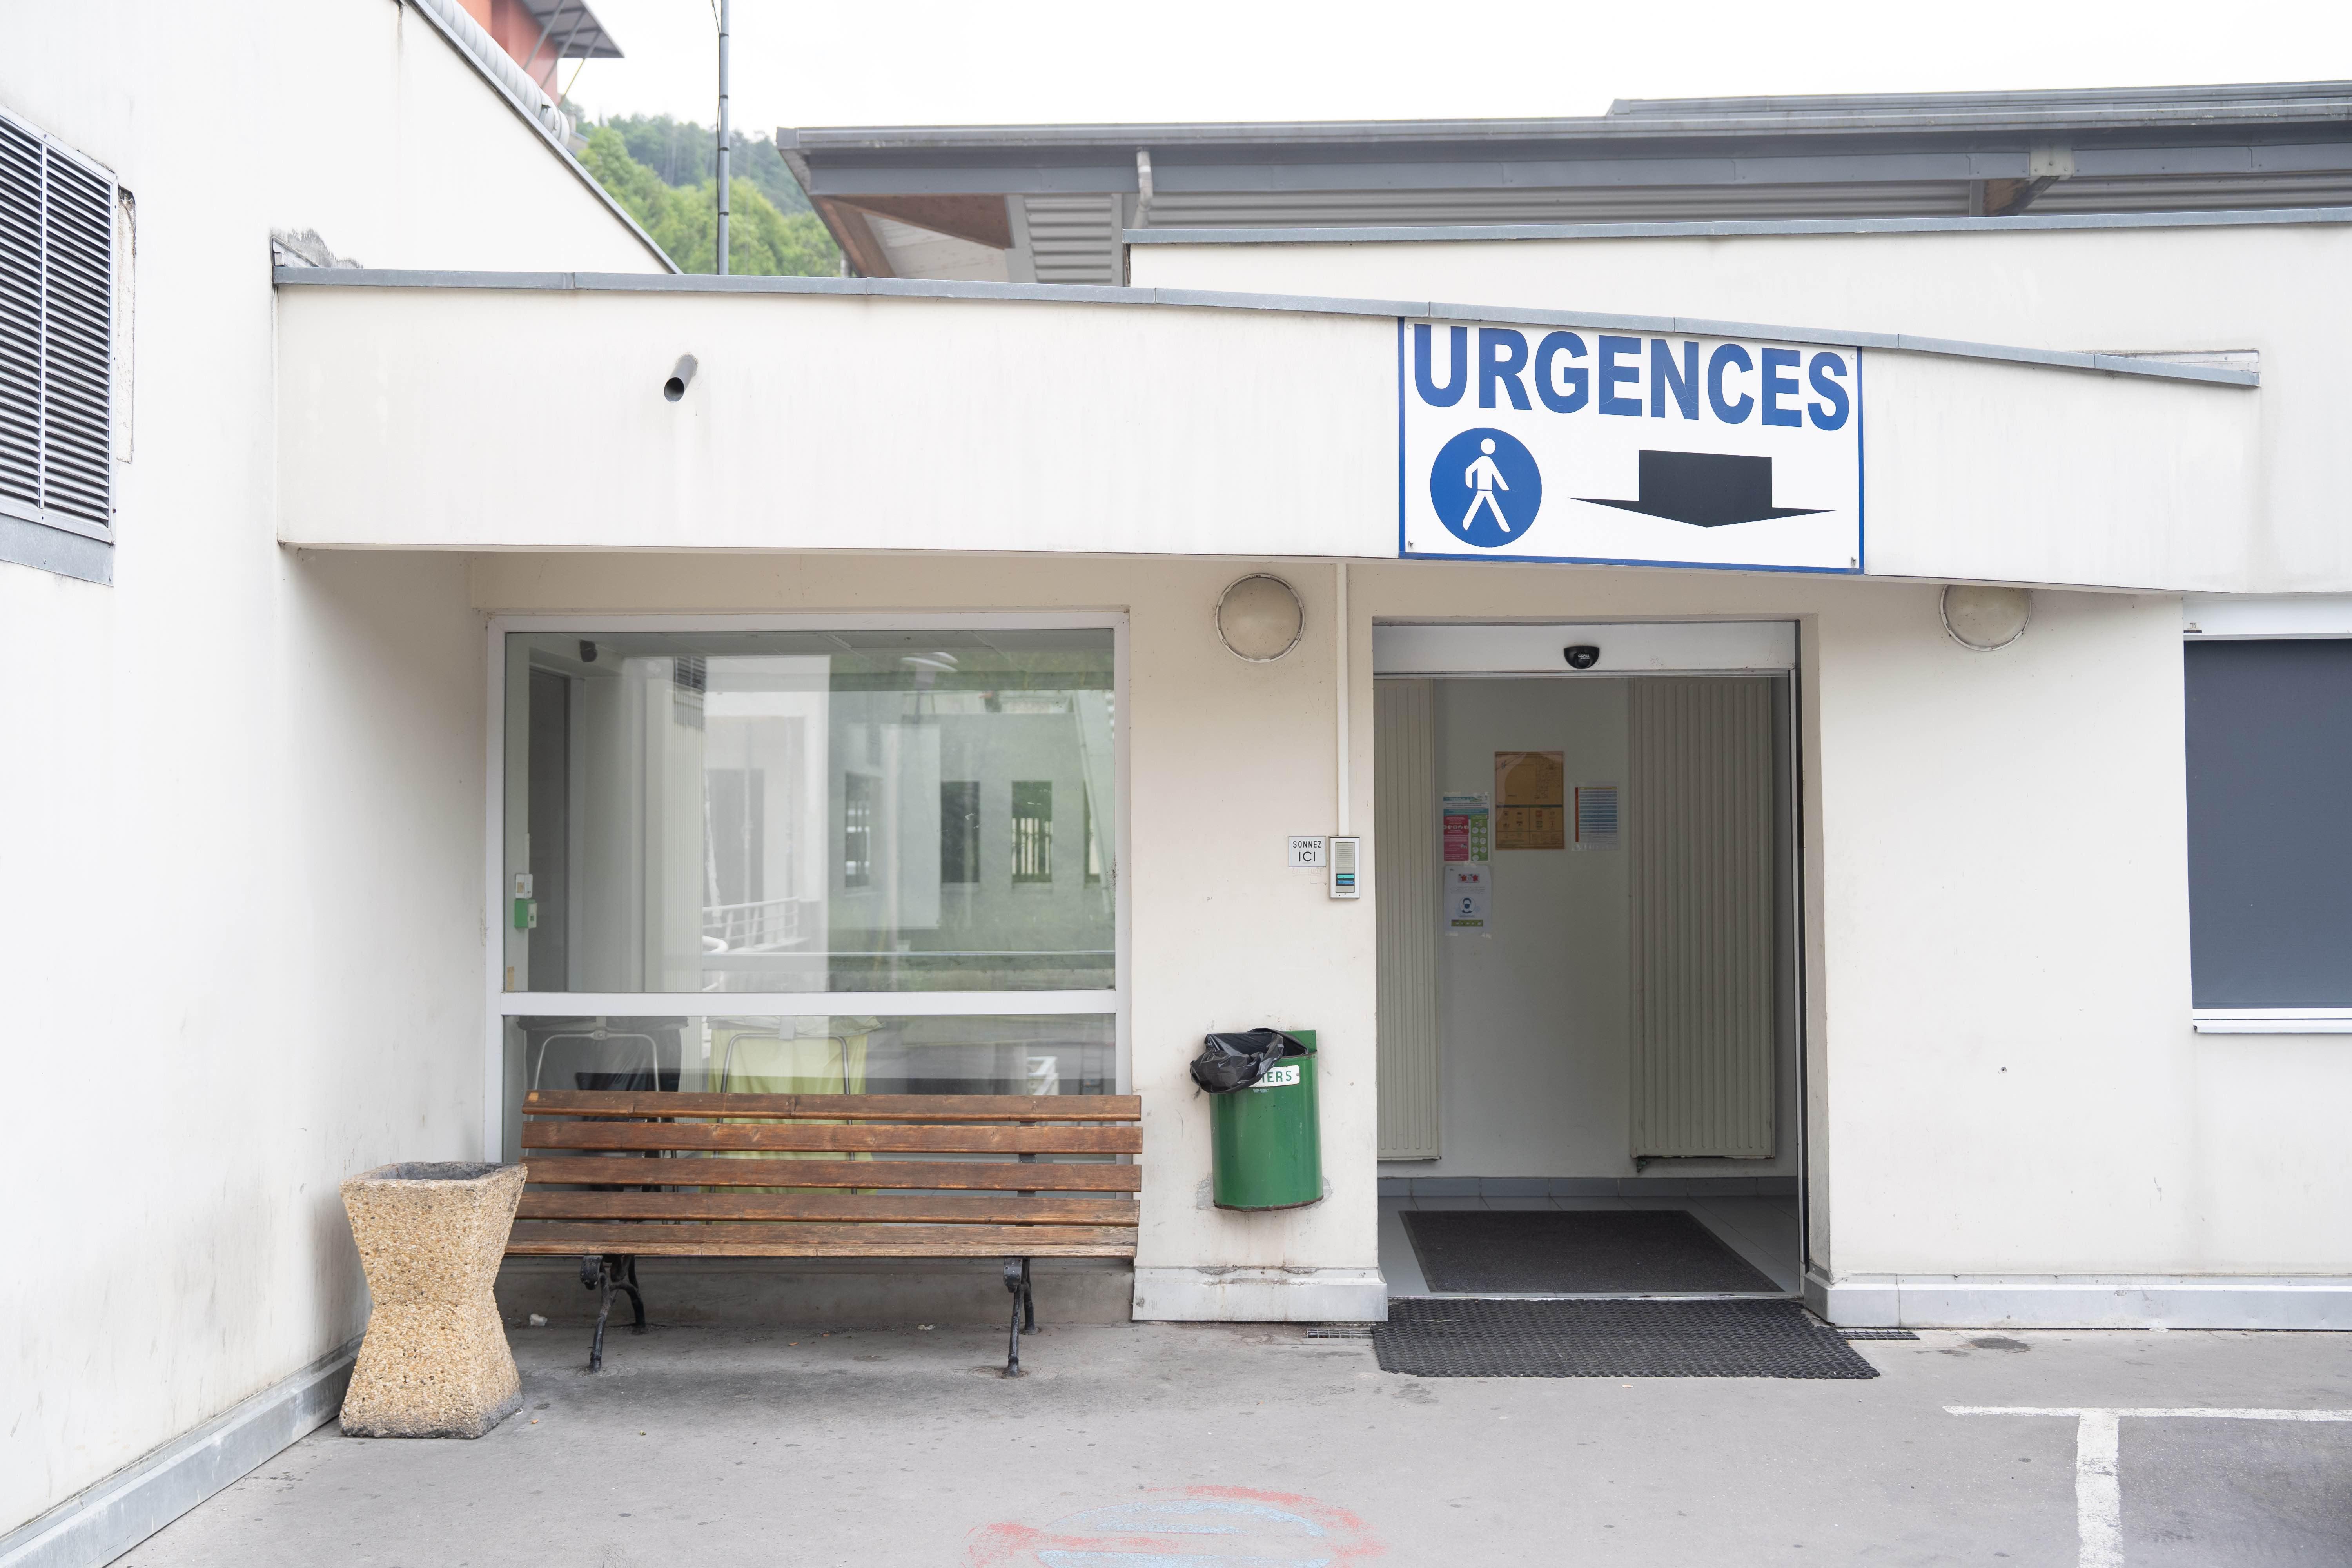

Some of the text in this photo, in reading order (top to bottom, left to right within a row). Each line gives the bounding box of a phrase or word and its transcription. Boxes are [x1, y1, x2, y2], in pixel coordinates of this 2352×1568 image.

[1414, 324, 1850, 431] URGENCES
[1299, 851, 1316, 862] ICI
[1262, 1071, 1292, 1083] IERS
